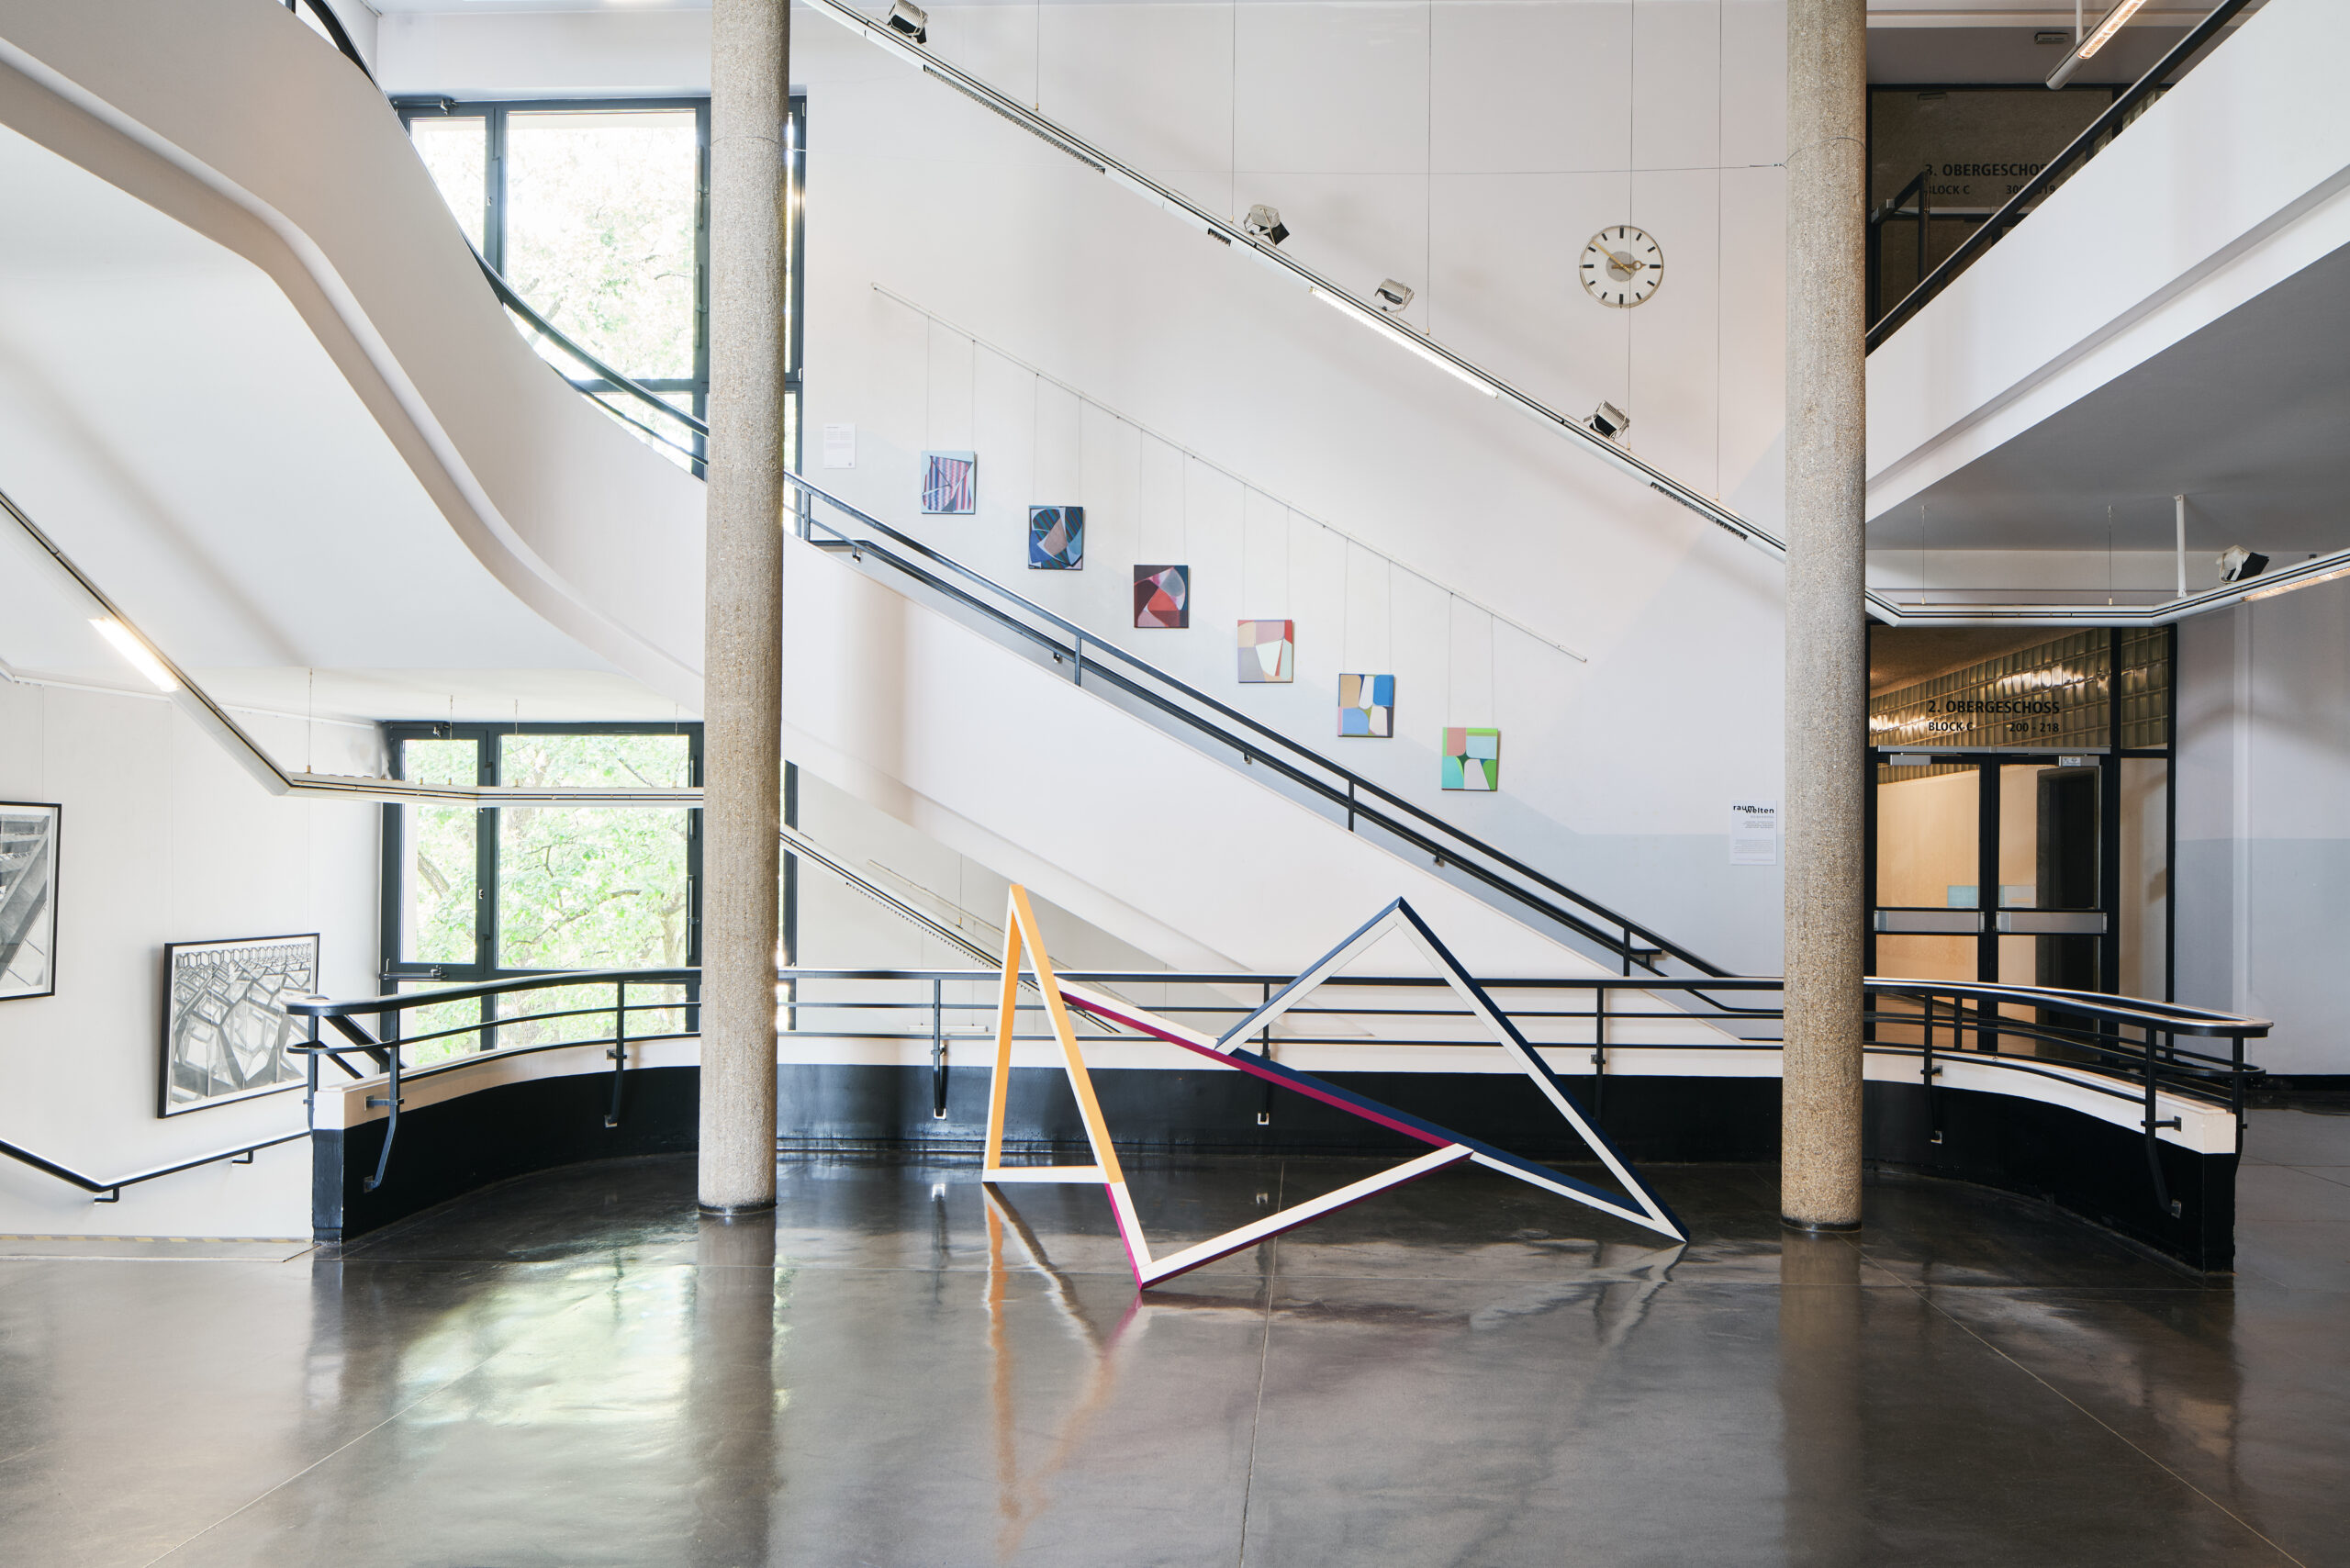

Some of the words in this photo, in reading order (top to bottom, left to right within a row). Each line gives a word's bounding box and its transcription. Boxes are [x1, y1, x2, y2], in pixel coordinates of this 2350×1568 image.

[1963, 185, 1970, 195] C
[1928, 700, 1941, 713] 2.
[1946, 700, 2060, 713] OBERGESCHOSS
[1929, 722, 1964, 732] BLOCK
[1966, 722, 1974, 732] C
[2009, 722, 2030, 733] 200
[2040, 722, 2059, 733] 218
